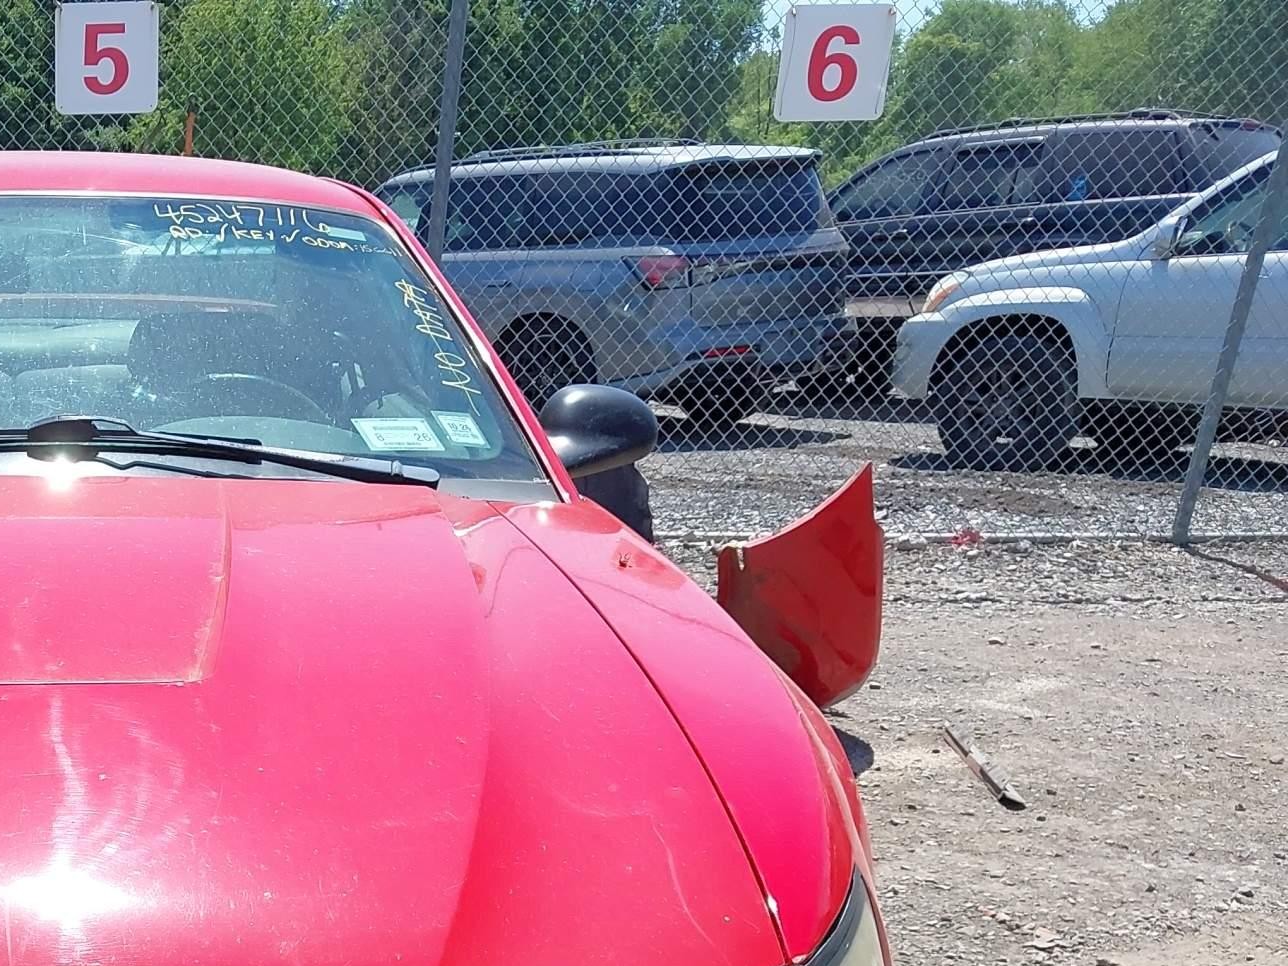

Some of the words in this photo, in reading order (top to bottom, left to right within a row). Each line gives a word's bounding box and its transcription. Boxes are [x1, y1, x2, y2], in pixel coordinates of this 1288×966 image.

[84, 23, 129, 95] 5
[807, 25, 860, 102] 6
[155, 203, 330, 233] 45247116
[232, 226, 274, 241] KEY
[395, 279, 453, 340] DATA
